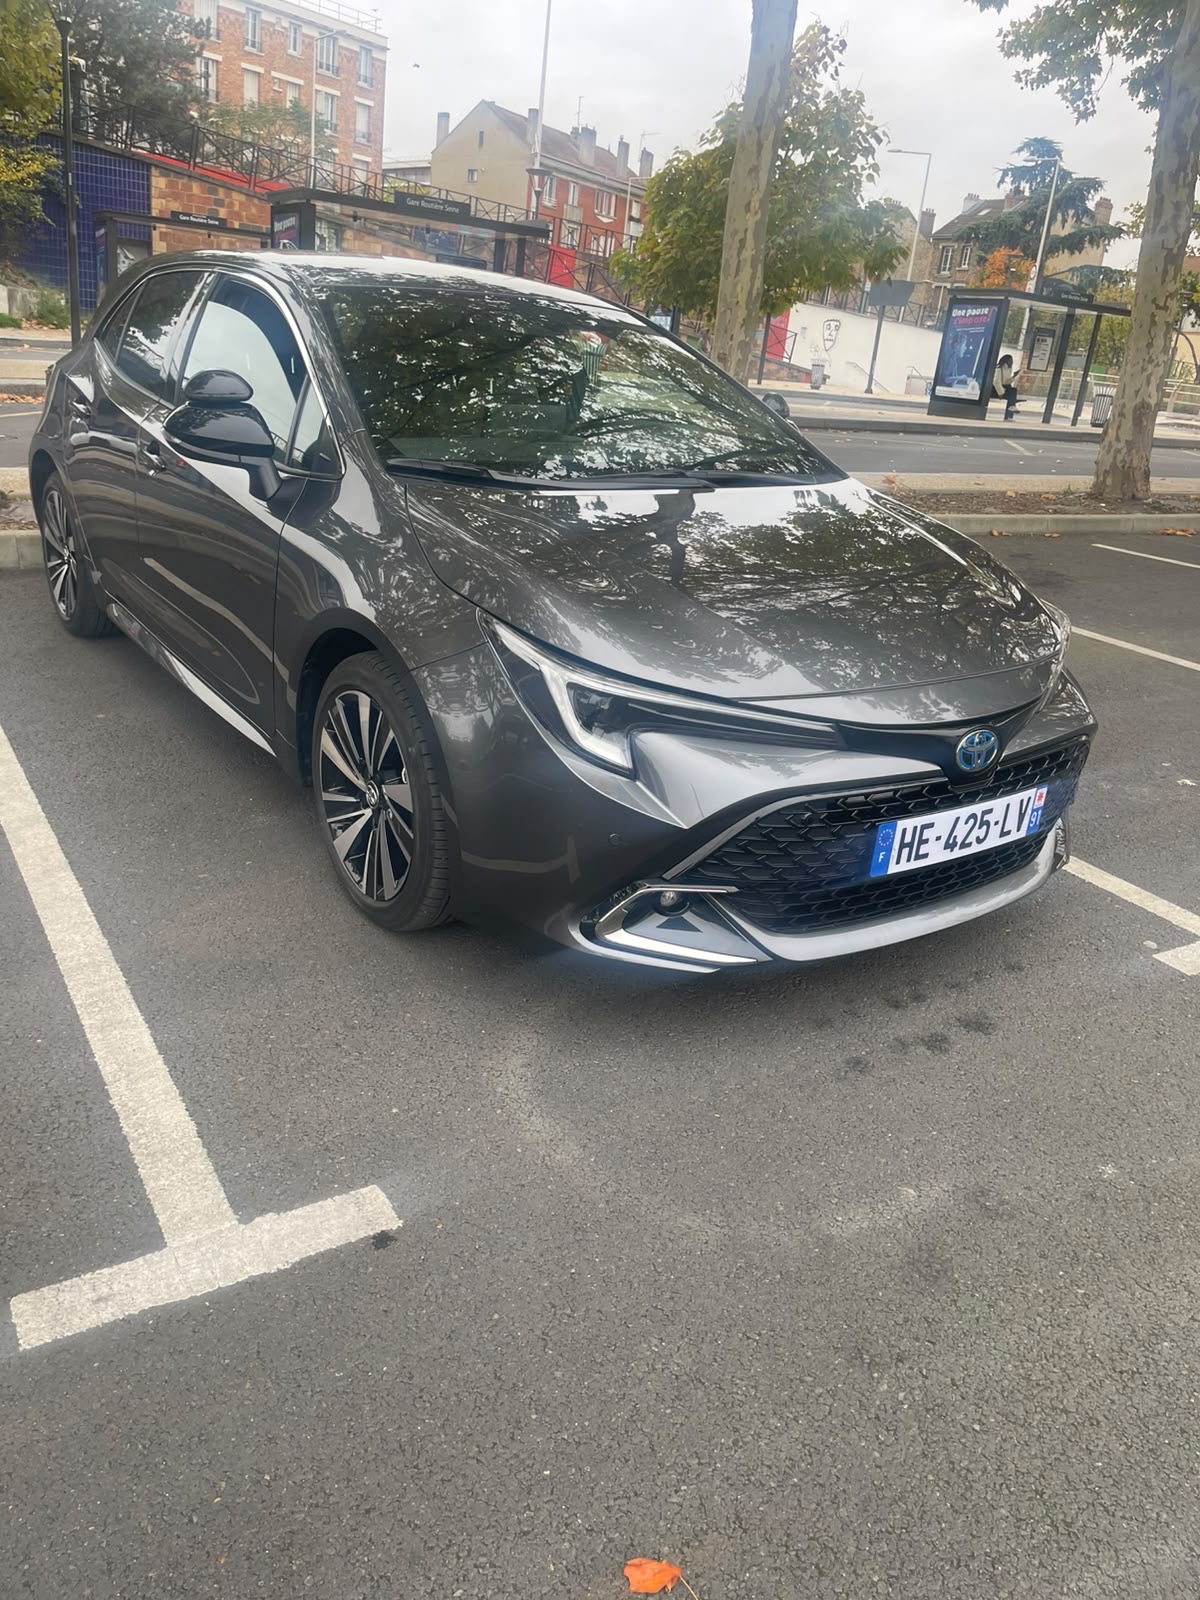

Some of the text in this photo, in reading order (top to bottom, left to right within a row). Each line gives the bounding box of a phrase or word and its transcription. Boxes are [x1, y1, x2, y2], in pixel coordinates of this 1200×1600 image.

[407, 198, 420, 206] Gare
[952, 307, 989, 317] Une pause
[1029, 810, 1042, 827] 91
[895, 797, 1032, 866] HE-425-LV
[878, 852, 885, 864] F
